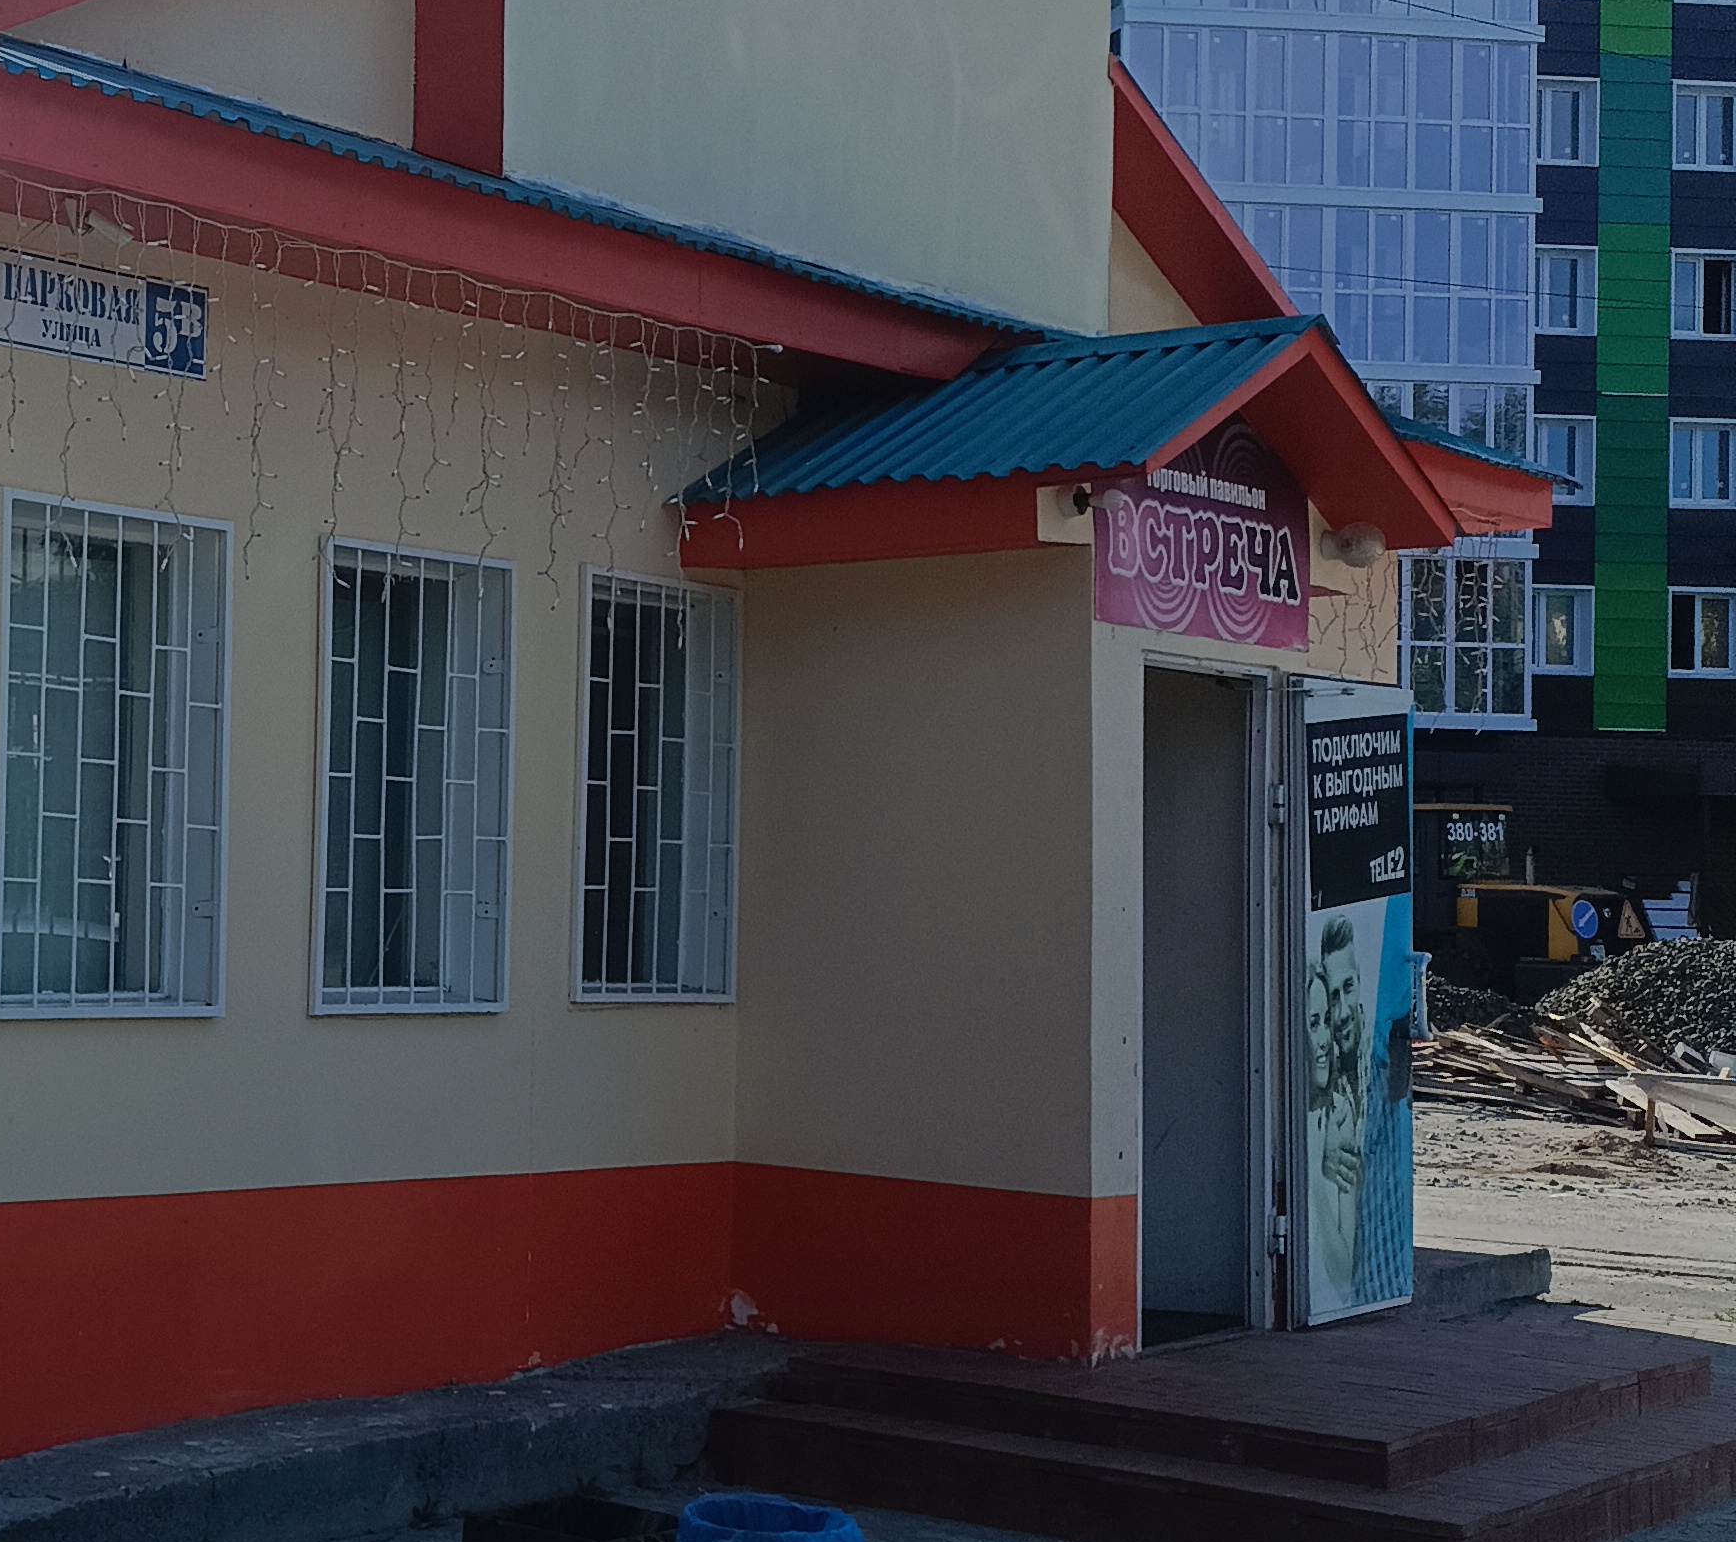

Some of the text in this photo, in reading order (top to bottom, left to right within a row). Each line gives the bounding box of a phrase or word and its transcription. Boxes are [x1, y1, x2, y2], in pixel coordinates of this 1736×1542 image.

[4, 262, 141, 326] ПАРКОВАЯ
[41, 319, 102, 350] УЛИЦА
[1210, 477, 1266, 511] павильон
[1107, 492, 1302, 607] ВСТРЕЧА
[1312, 729, 1401, 767] ПОДКЛЮЧИМ
[1313, 763, 1404, 799] К ВЫГОДНЫМ
[1314, 800, 1379, 835] ТАРИФАМ
[1369, 845, 1406, 884] TELE2
